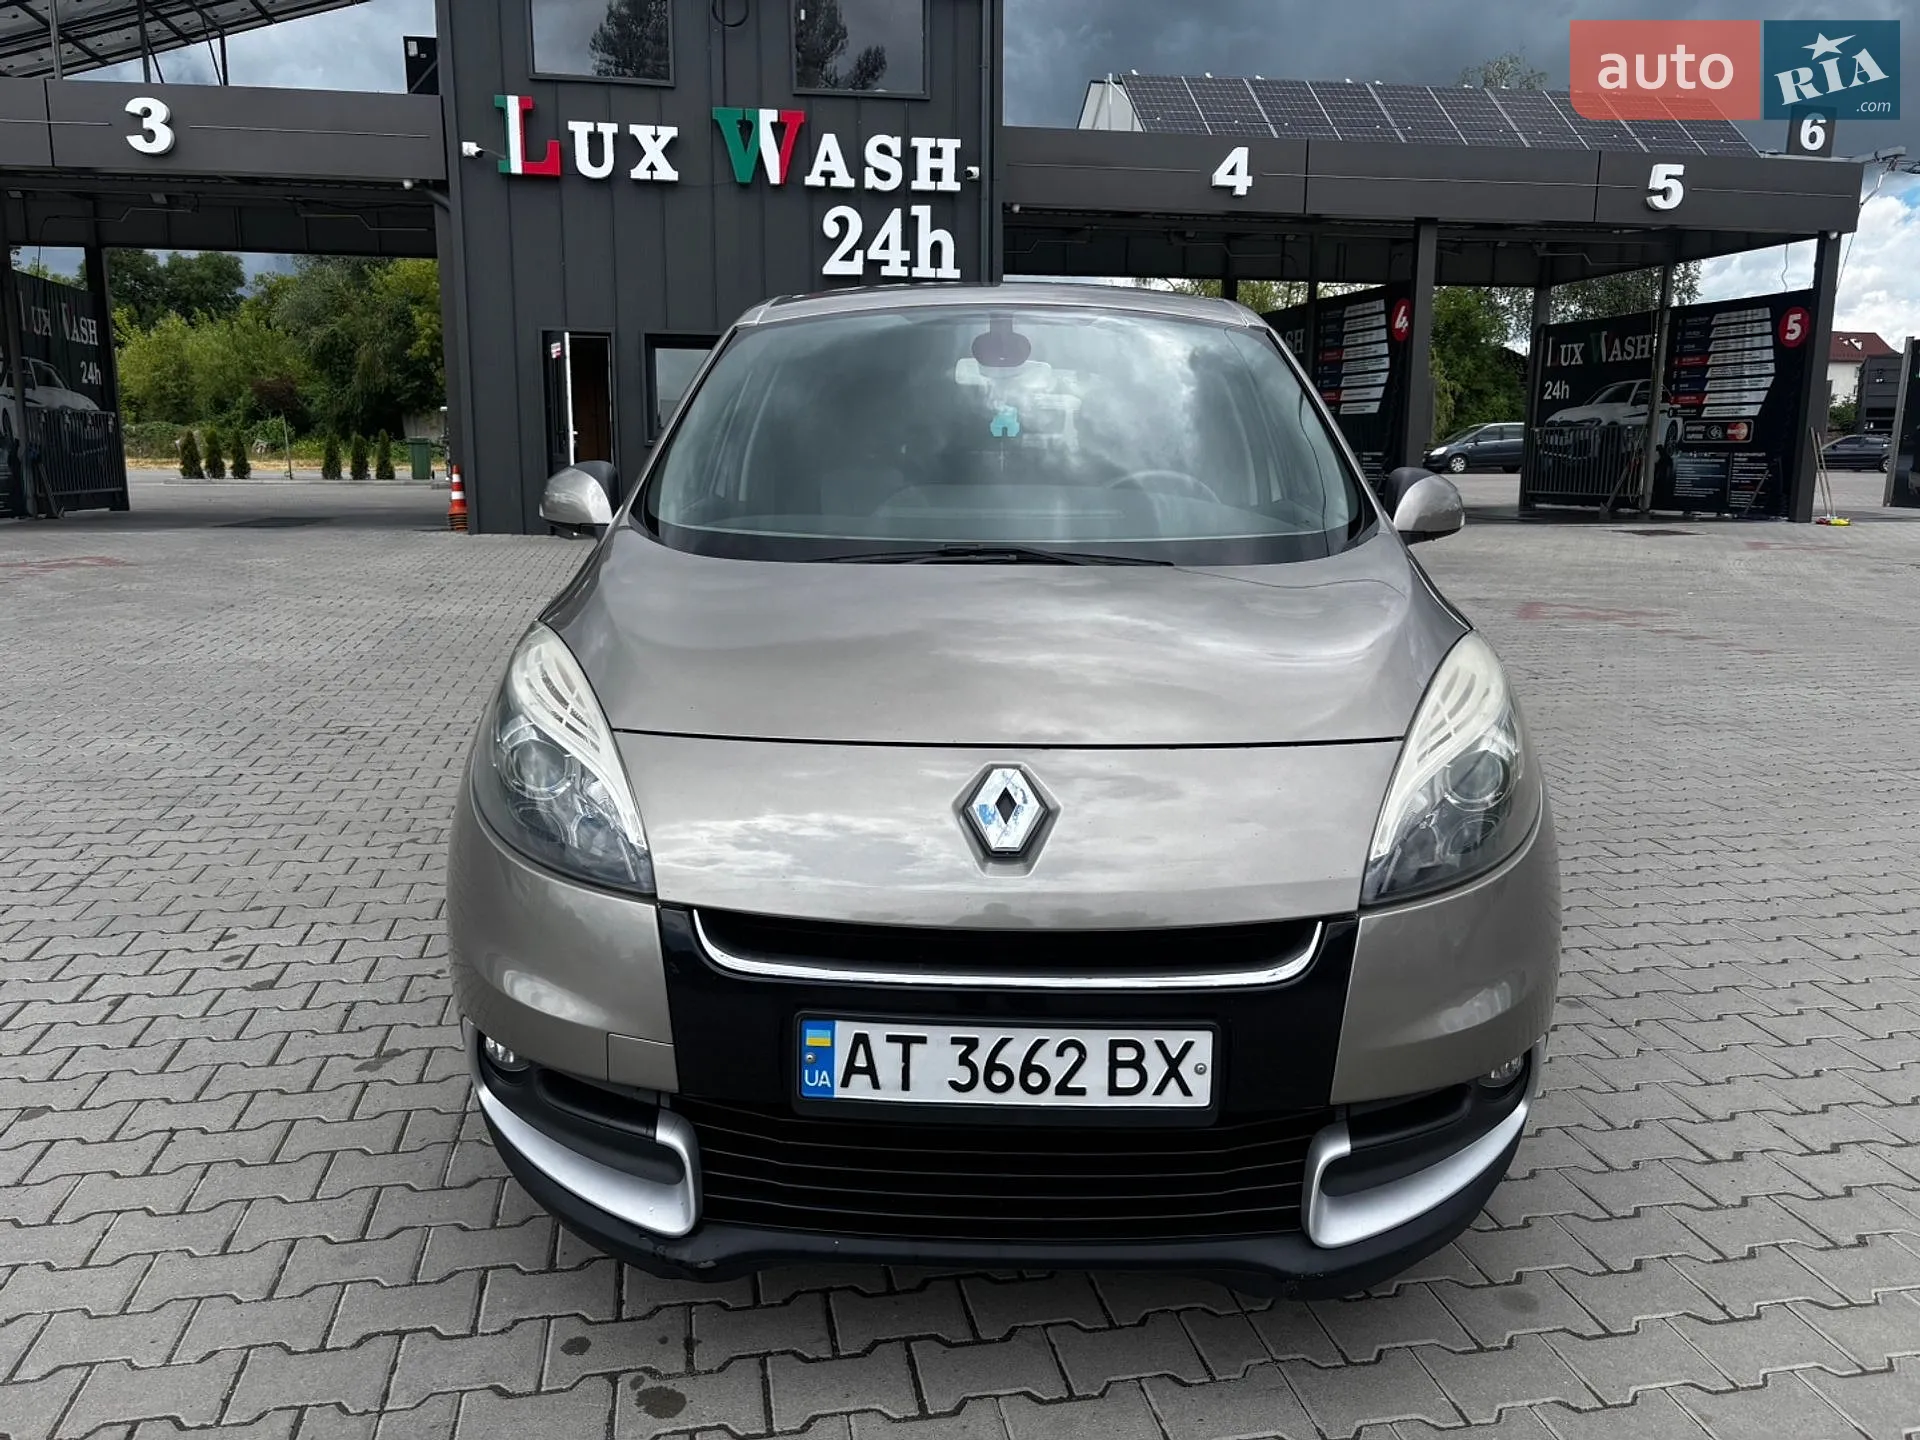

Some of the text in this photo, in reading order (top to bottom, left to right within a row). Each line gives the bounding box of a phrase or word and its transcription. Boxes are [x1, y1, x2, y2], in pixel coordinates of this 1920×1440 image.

[125, 97, 175, 156] 3
[494, 95, 961, 191] LUX WASH
[1800, 112, 1826, 151] 6
[1211, 146, 1253, 197] 4
[1646, 163, 1685, 211] 5
[822, 205, 961, 279] 24h
[1394, 306, 1409, 333] 4
[1785, 313, 1802, 341] 5
[80, 361, 102, 385] 24h
[1542, 380, 1570, 400] 24h
[804, 1070, 831, 1088] UA
[840, 1032, 1196, 1098] AT 3662 BX
